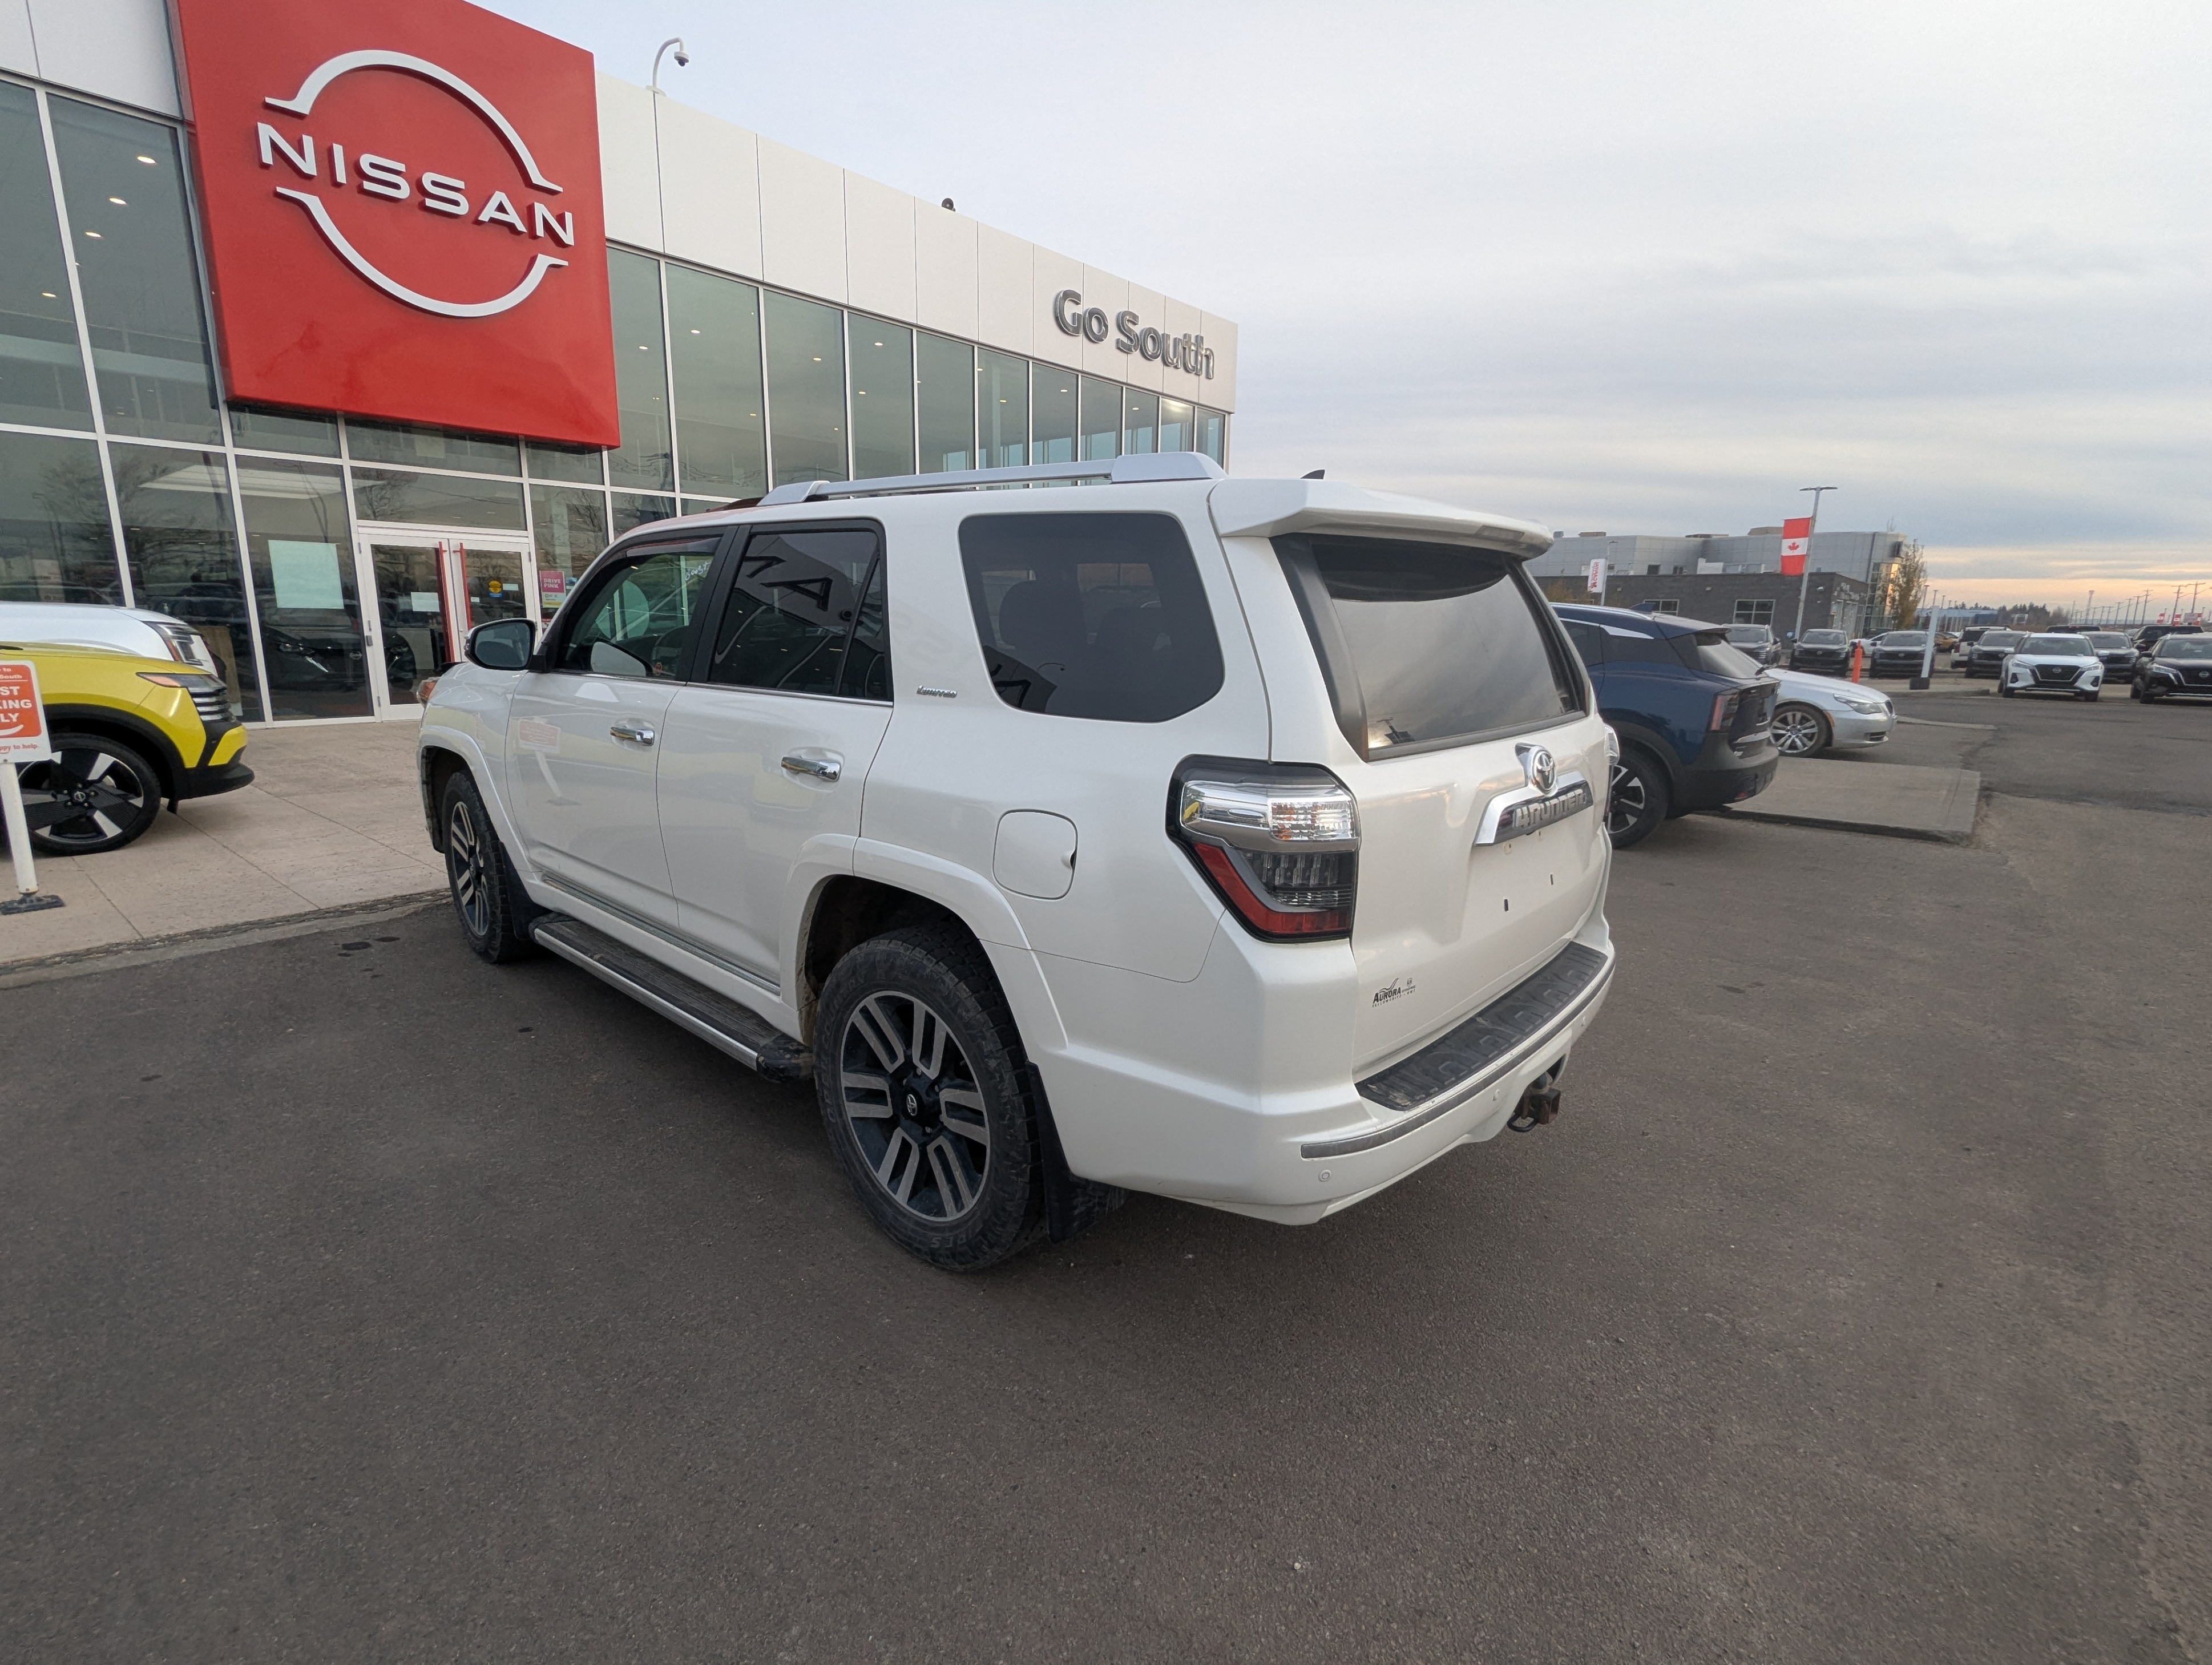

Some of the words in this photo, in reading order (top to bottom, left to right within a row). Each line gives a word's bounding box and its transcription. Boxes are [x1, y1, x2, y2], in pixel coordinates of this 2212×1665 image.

[256, 122, 575, 247] NISSAN
[1055, 289, 1109, 343] Go
[1116, 310, 1215, 379] South
[0, 699, 33, 709] ING
[1373, 987, 1401, 1004] AURORA
